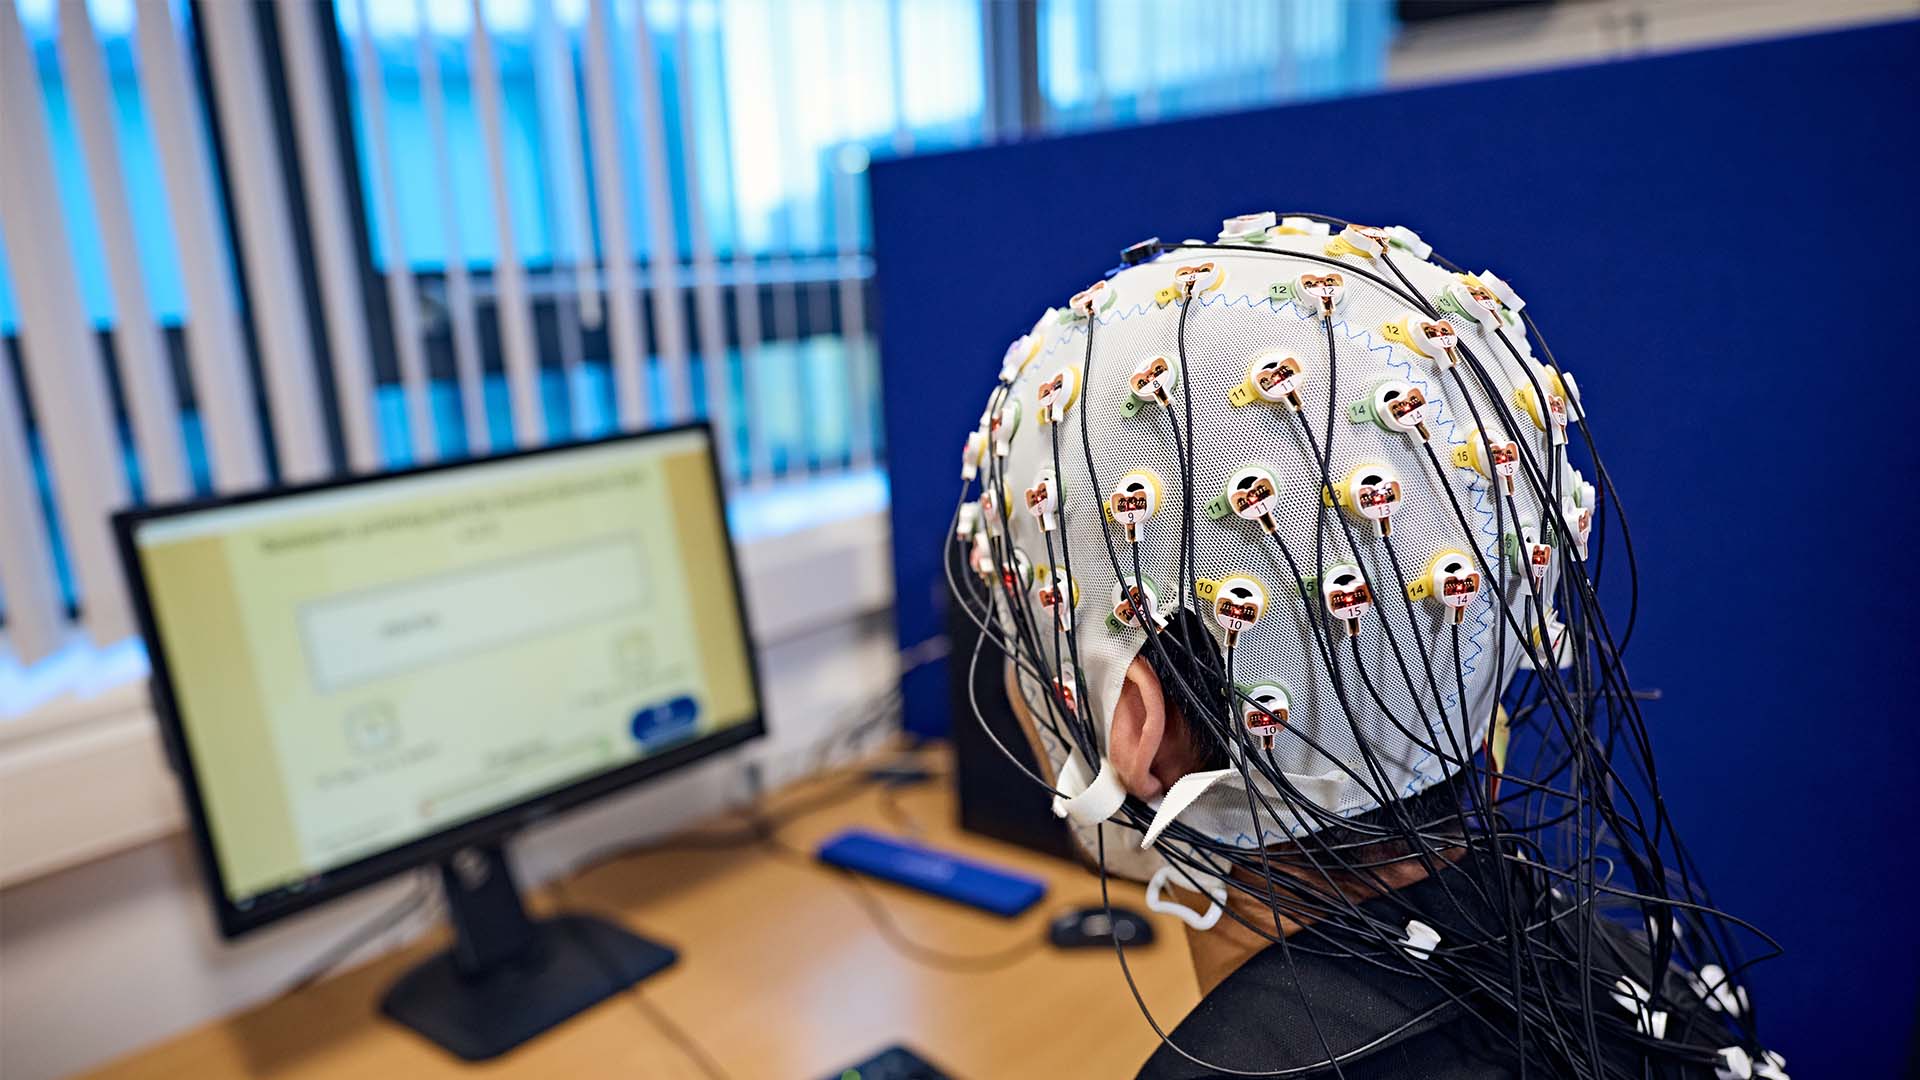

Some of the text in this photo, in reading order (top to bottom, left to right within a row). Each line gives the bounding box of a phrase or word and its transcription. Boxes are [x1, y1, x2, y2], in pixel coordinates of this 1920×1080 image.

[1271, 286, 1287, 294] 12
[1322, 287, 1335, 295] 12
[1386, 325, 1399, 335] 12
[1440, 337, 1452, 345] 12
[1153, 380, 1160, 388] 8
[1281, 379, 1294, 391] 11
[1232, 388, 1246, 400] 11
[1125, 402, 1134, 410] 8
[1351, 405, 1366, 416] 14
[1410, 411, 1422, 422] 14
[1504, 463, 1514, 474] 15
[1208, 502, 1221, 514] 11
[1255, 502, 1267, 514] 11
[1379, 505, 1391, 516] 13
[1128, 512, 1134, 522] 9
[1199, 582, 1213, 594] 10
[1410, 584, 1424, 596] 14
[1457, 595, 1468, 605] 14
[1348, 606, 1362, 617] 15
[1230, 619, 1242, 629] 10
[1264, 726, 1277, 735] 10
